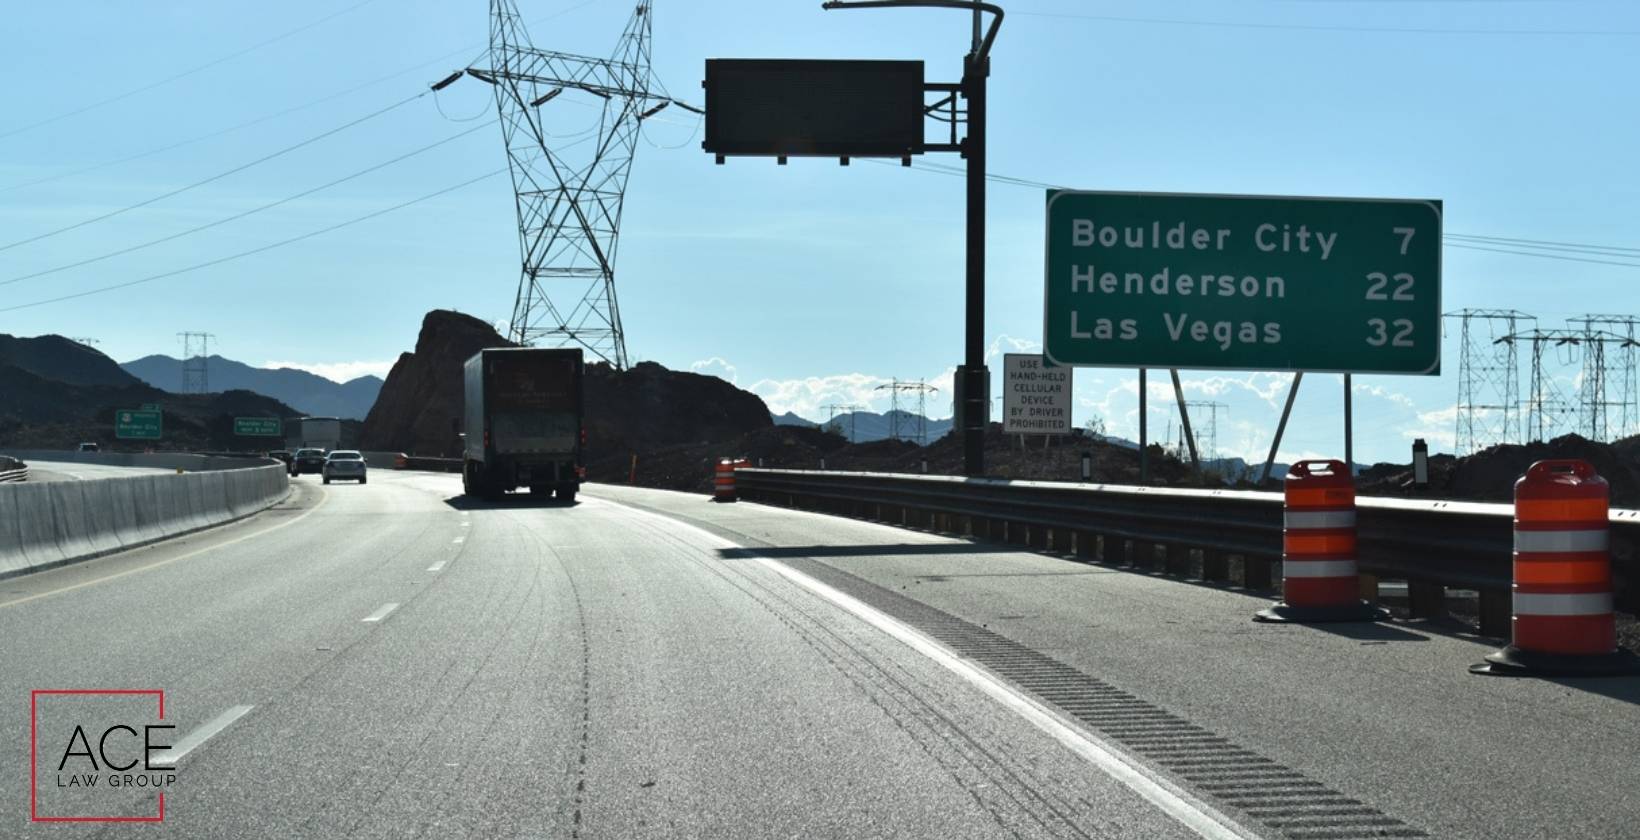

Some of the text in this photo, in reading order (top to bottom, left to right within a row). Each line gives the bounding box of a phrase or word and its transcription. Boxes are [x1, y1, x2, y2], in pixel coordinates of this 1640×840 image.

[1071, 218, 1416, 261] Boulder City 7
[1070, 264, 1416, 302] Henderson 22
[1069, 310, 1416, 351] Las Vegas 32
[1019, 360, 1039, 369] USE
[1010, 371, 1066, 382] HAND-HELD
[1013, 383, 1062, 393] CELLULAR
[1020, 395, 1056, 405] DEVICE
[1011, 407, 1064, 417] BY DRIVER
[1009, 419, 1065, 429] PROHIBITED
